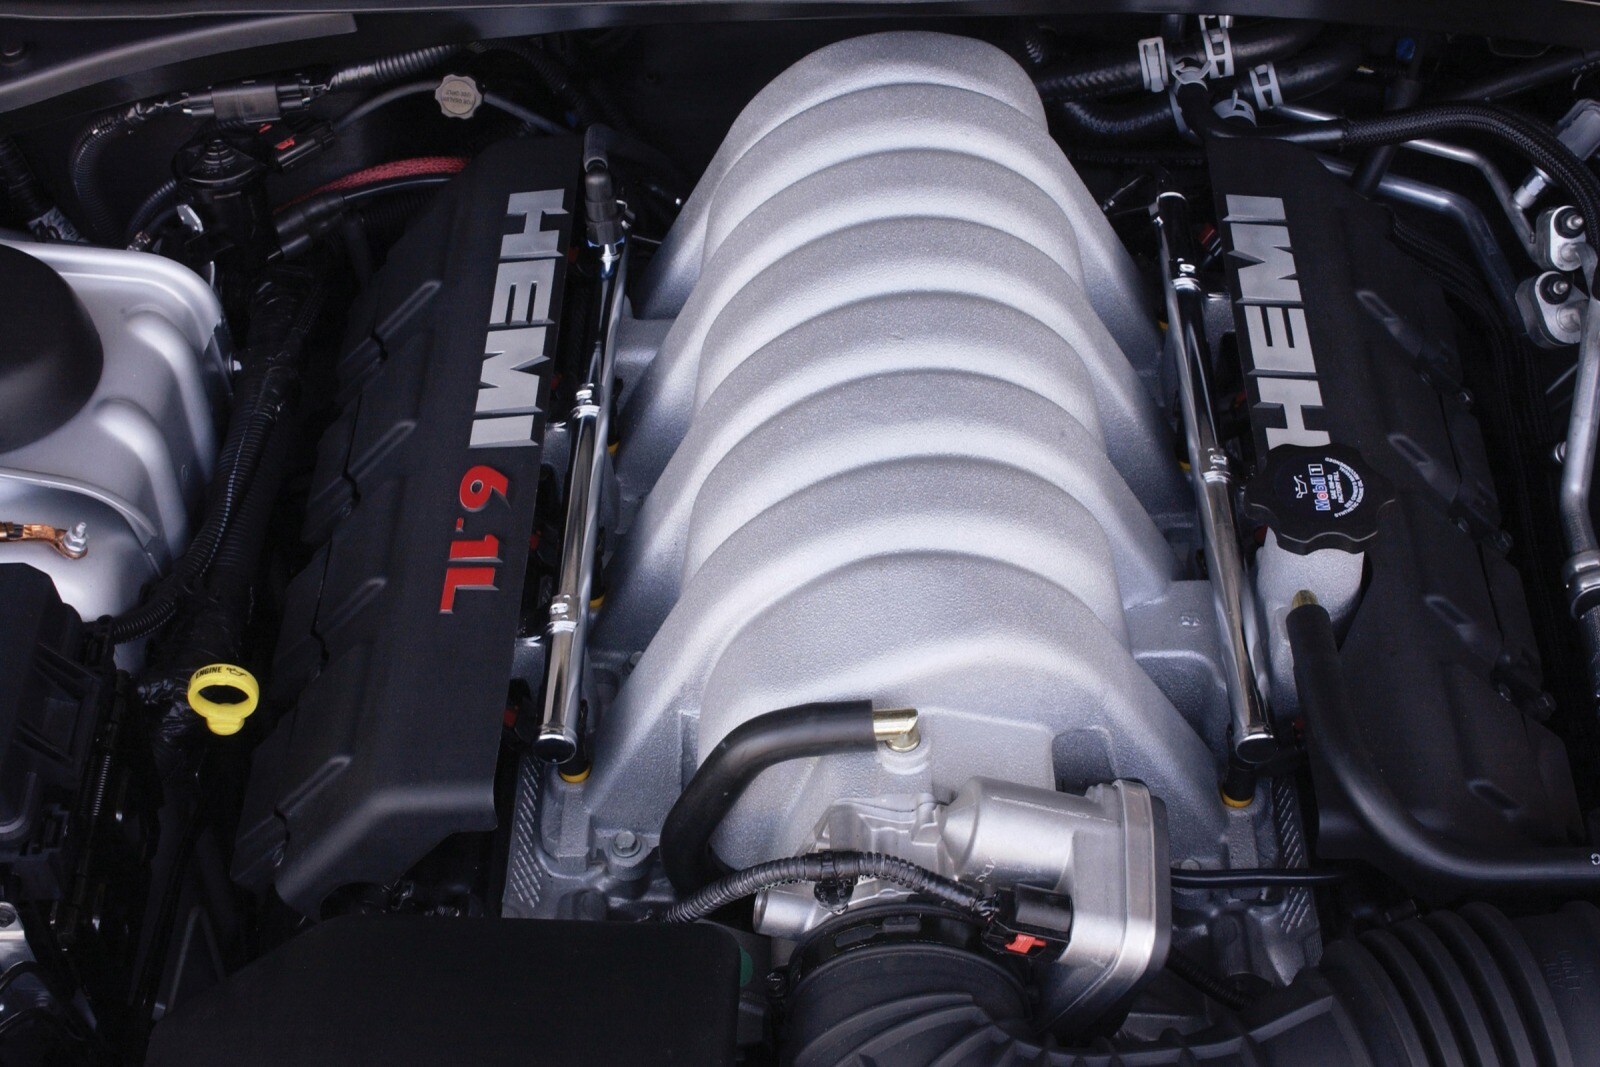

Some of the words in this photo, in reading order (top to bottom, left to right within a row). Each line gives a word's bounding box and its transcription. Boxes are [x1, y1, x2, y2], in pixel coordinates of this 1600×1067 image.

[469, 188, 567, 449] HEMI
[1224, 194, 1331, 450] HEMI
[1332, 471, 1340, 482] FILL
[1335, 482, 1344, 503] FACTORY
[1310, 477, 1331, 511] Mobil
[440, 465, 509, 614] 6.1L
[195, 666, 223, 679] ENGINE
